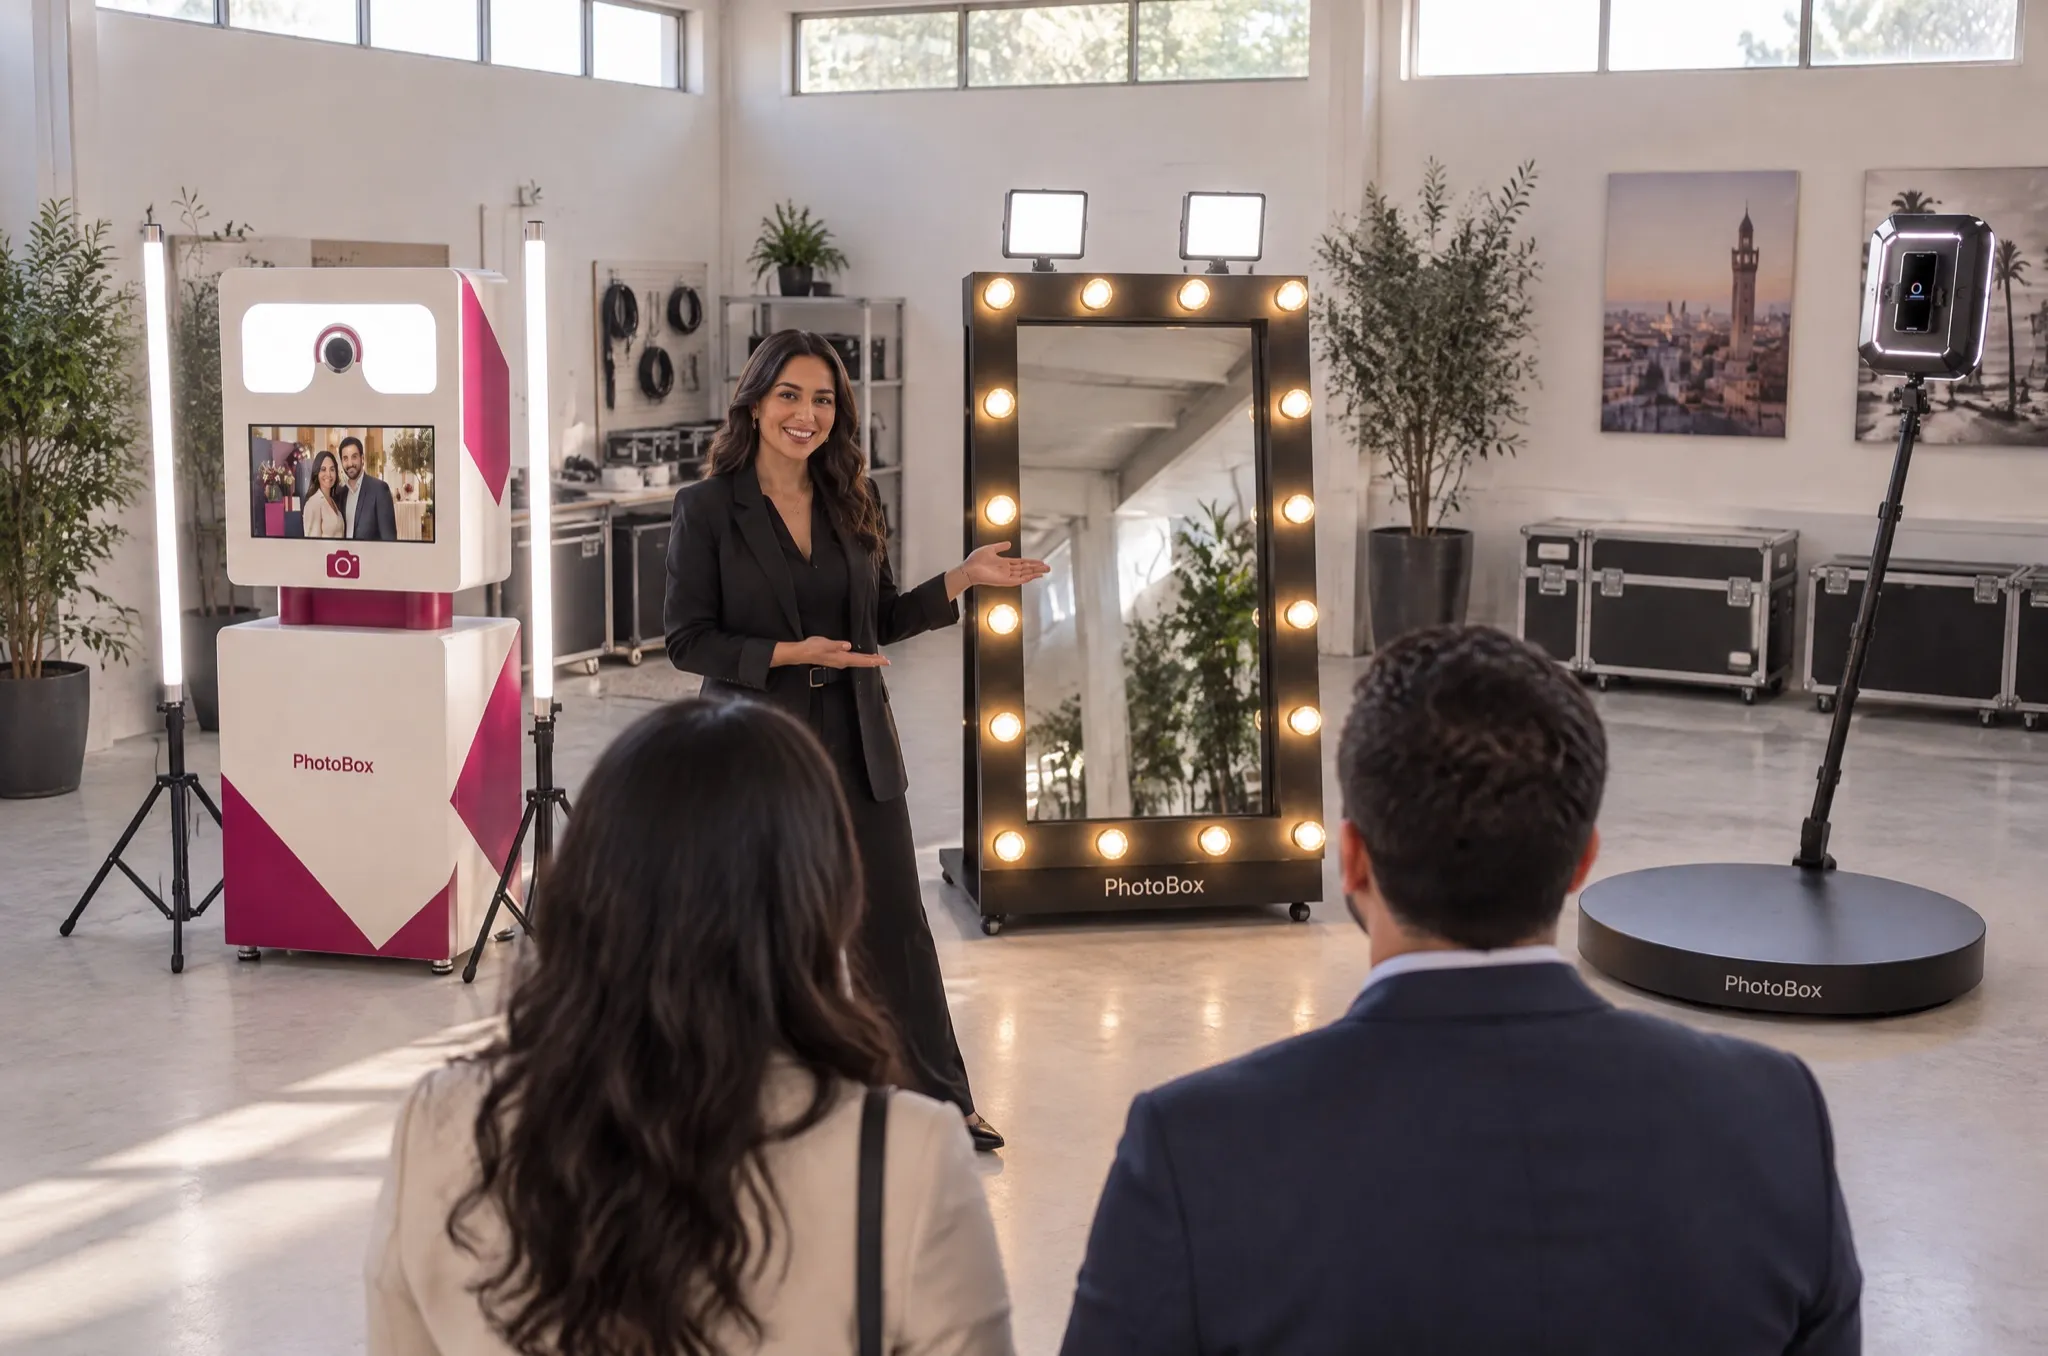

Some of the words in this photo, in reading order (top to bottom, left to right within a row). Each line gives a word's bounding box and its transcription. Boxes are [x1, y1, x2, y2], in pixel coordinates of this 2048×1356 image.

[293, 753, 373, 774] PhotoBox
[1105, 876, 1204, 897] PhotoBox
[1725, 974, 1822, 998] PhotoBox
